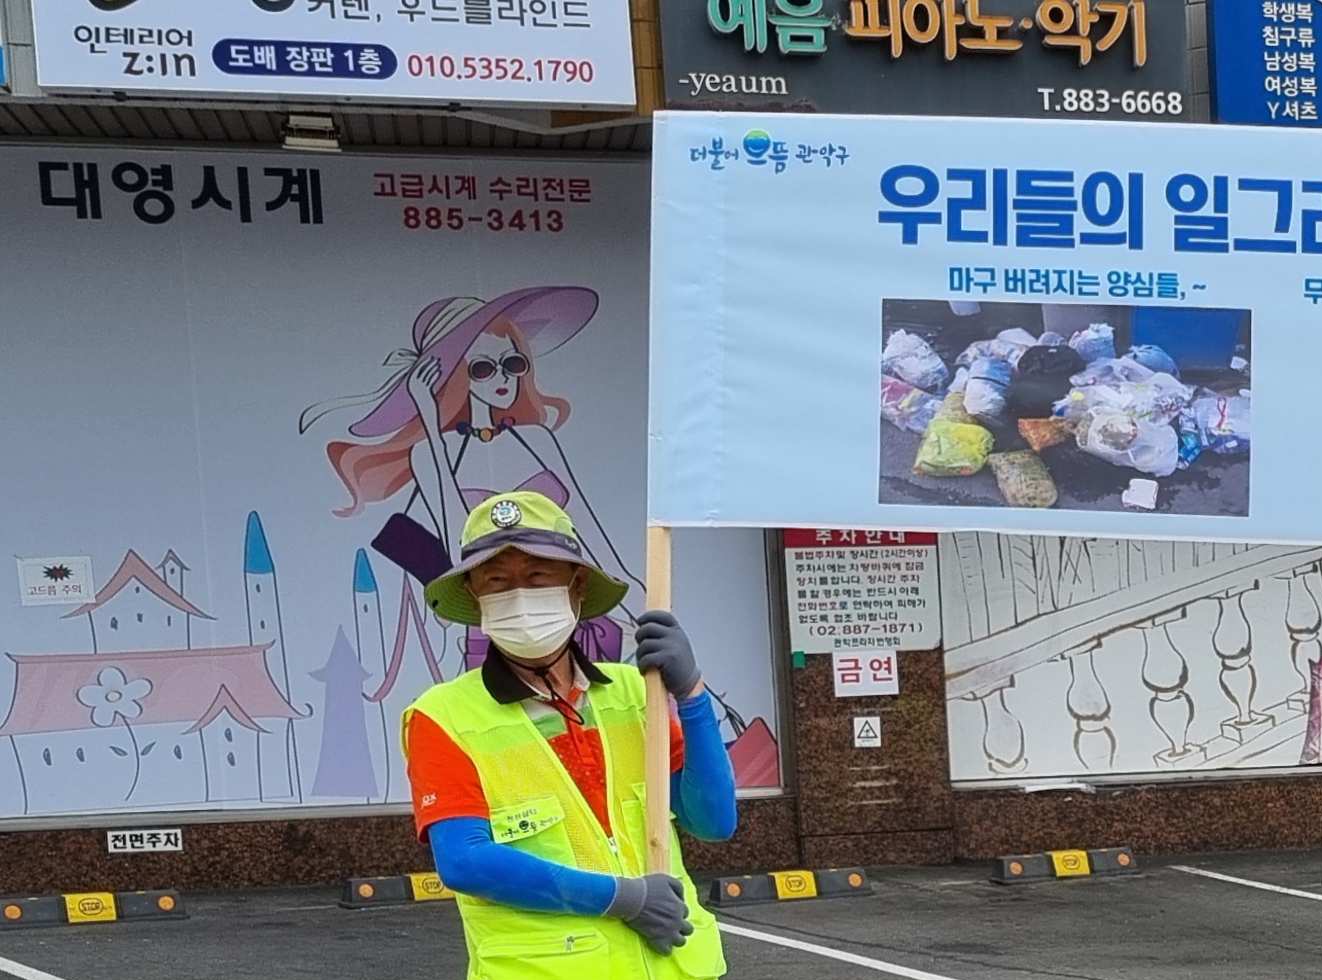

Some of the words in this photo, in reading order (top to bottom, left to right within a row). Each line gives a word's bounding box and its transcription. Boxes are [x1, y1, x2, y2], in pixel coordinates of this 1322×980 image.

[1262, 2, 1313, 23] 학생복
[73, 25, 193, 54] 인테리어
[1262, 27, 1316, 48] 침구류
[228, 44, 278, 71] 도배
[285, 46, 334, 73] 장판
[344, 48, 383, 75] 1층
[407, 54, 594, 83] 010.5352.1790
[1263, 52, 1317, 73] 남성복
[1264, 76, 1318, 97] 여성복
[1037, 87, 1183, 114] T.883-6668
[690, 136, 739, 171] 더불어
[795, 143, 850, 168] 관악구
[38, 160, 324, 226] 대영시계
[372, 173, 478, 201] 고급시계
[488, 175, 592, 203] 수리전문
[403, 207, 565, 233] 885-3413
[878, 164, 1144, 251] 우리들의
[949, 267, 997, 294] 마구
[1004, 268, 1100, 297] 버려지는
[63, 584, 81, 595] 주의
[837, 657, 893, 684] 금연
[110, 832, 181, 850] 전면주차
[82, 901, 102, 912] STOP
